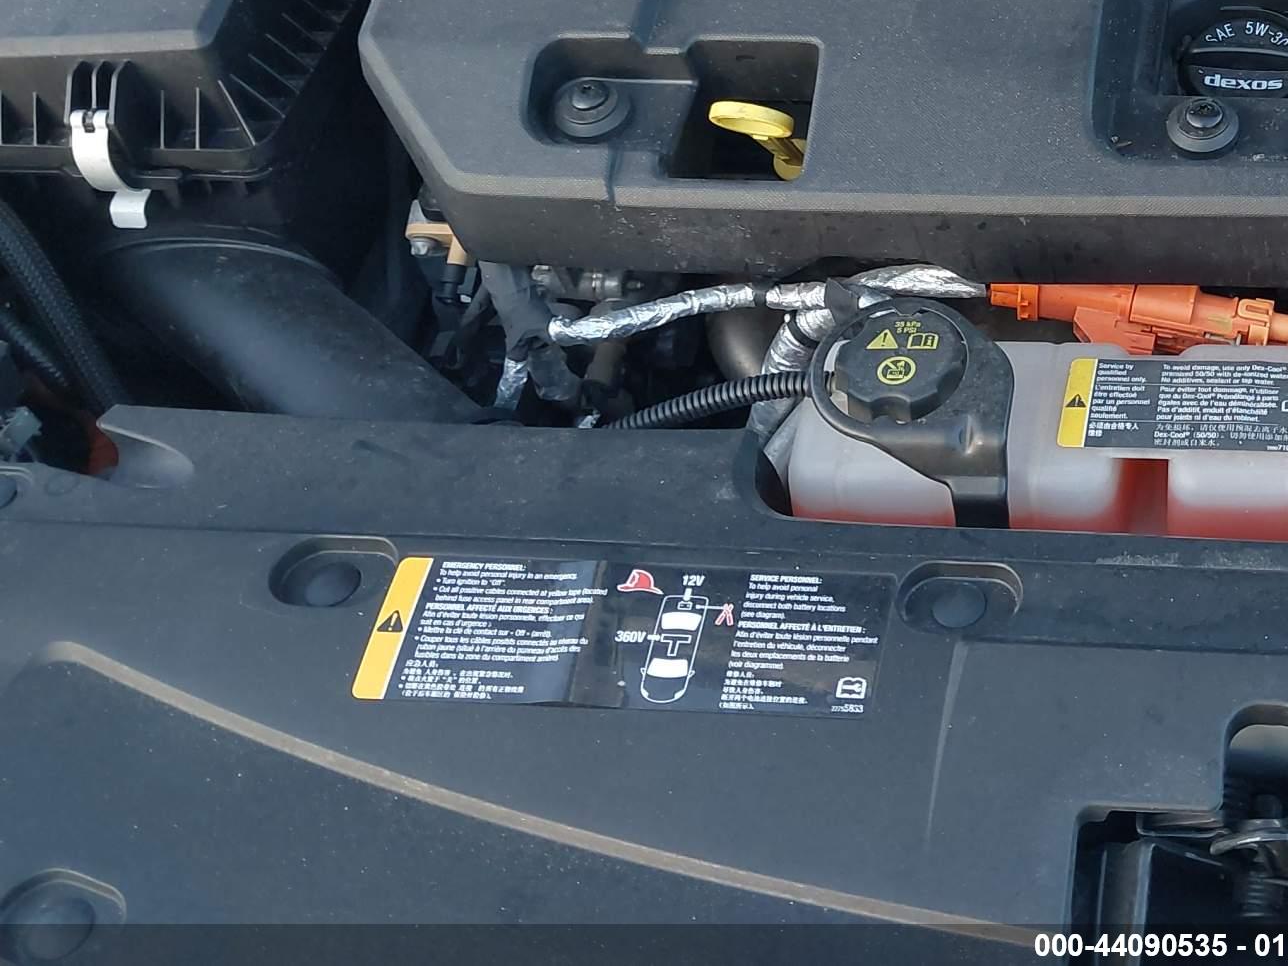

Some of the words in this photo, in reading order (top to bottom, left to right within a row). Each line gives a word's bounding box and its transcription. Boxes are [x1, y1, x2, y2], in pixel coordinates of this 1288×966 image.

[1206, 23, 1236, 42] SAE
[1204, 74, 1284, 90] dexos
[682, 575, 705, 586] 12V
[615, 631, 646, 642] 360V
